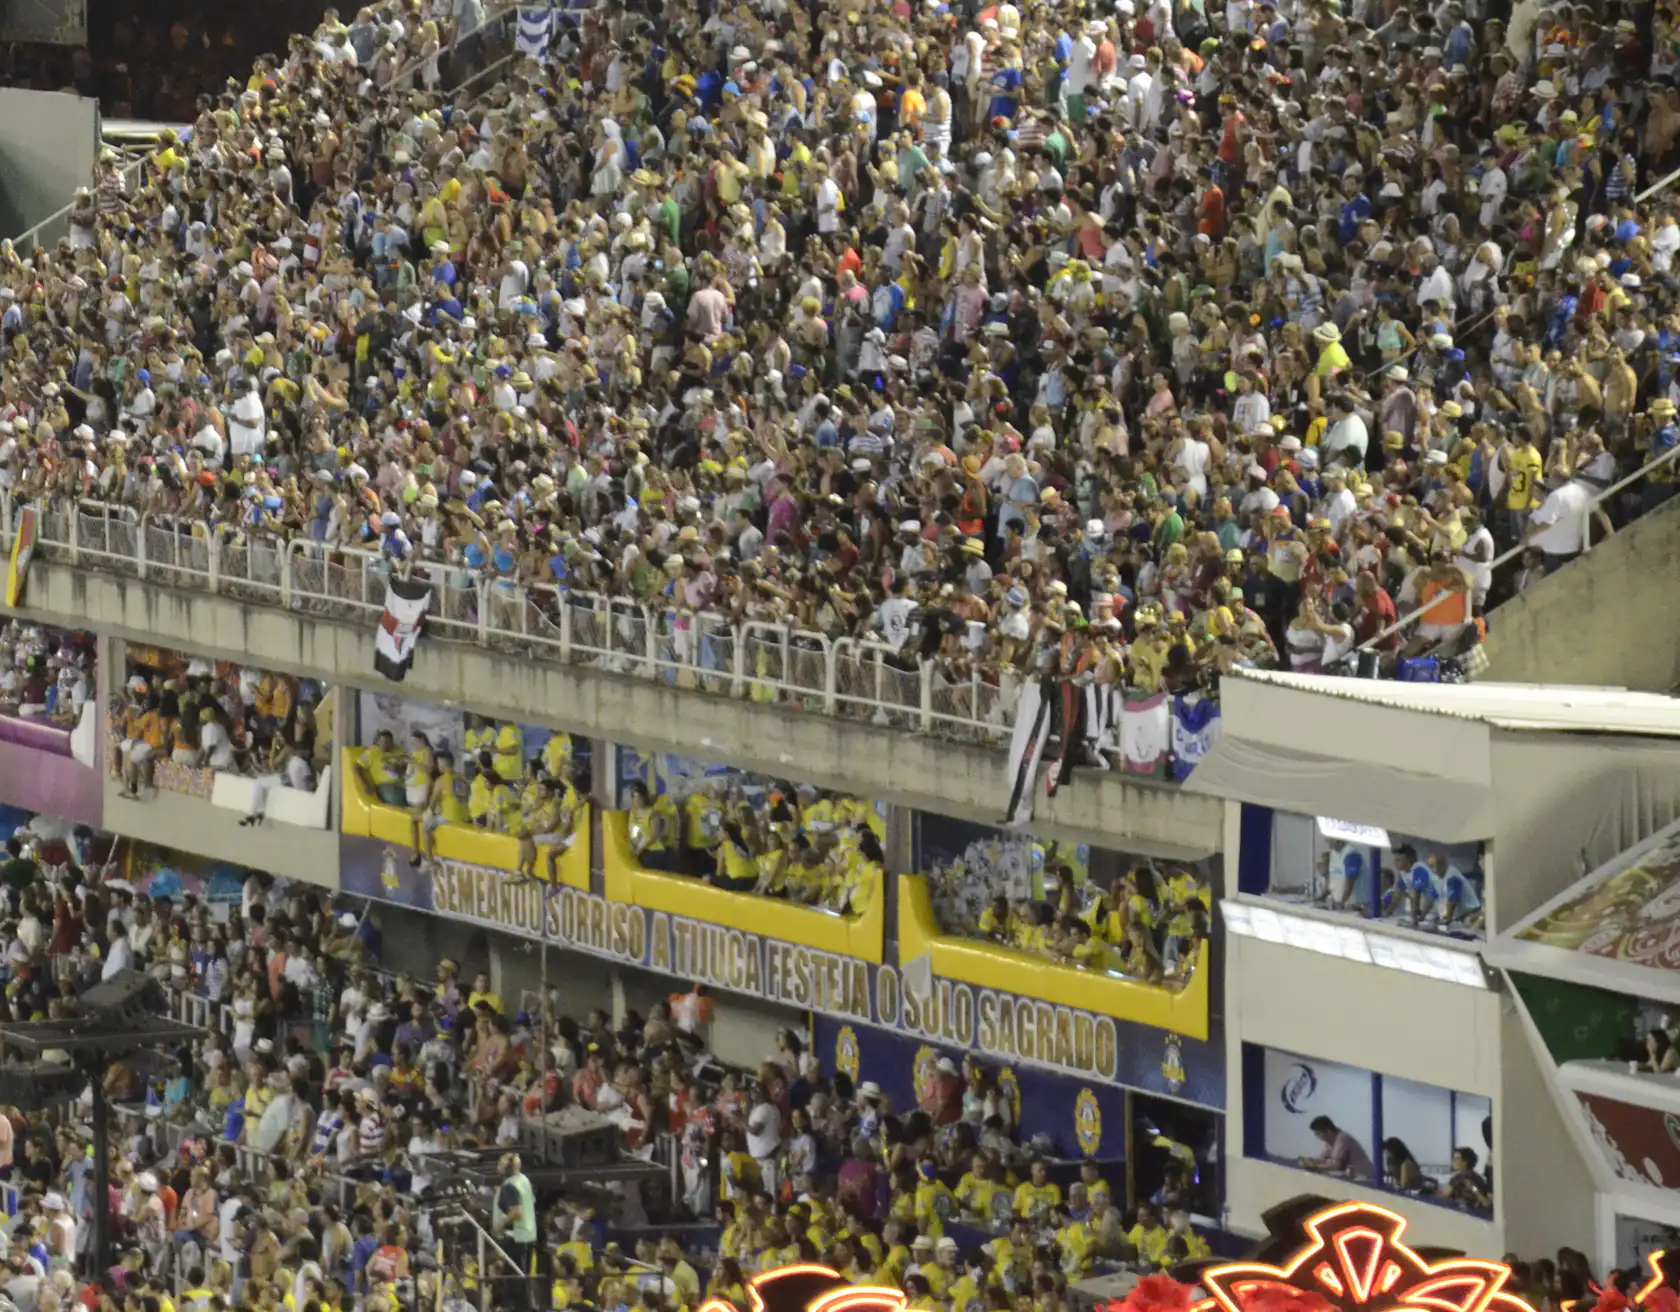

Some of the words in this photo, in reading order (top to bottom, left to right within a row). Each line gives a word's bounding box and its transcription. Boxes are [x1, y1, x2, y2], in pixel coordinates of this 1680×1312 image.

[432, 856, 544, 937] SEMEANDO
[546, 884, 646, 964] SORRISO
[650, 911, 671, 971] A
[672, 916, 765, 997] TIJUCA
[766, 940, 871, 1020] FESTEJA
[877, 964, 899, 1027] O
[901, 974, 975, 1046] SOLO
[978, 989, 1118, 1082] SAGRADO
